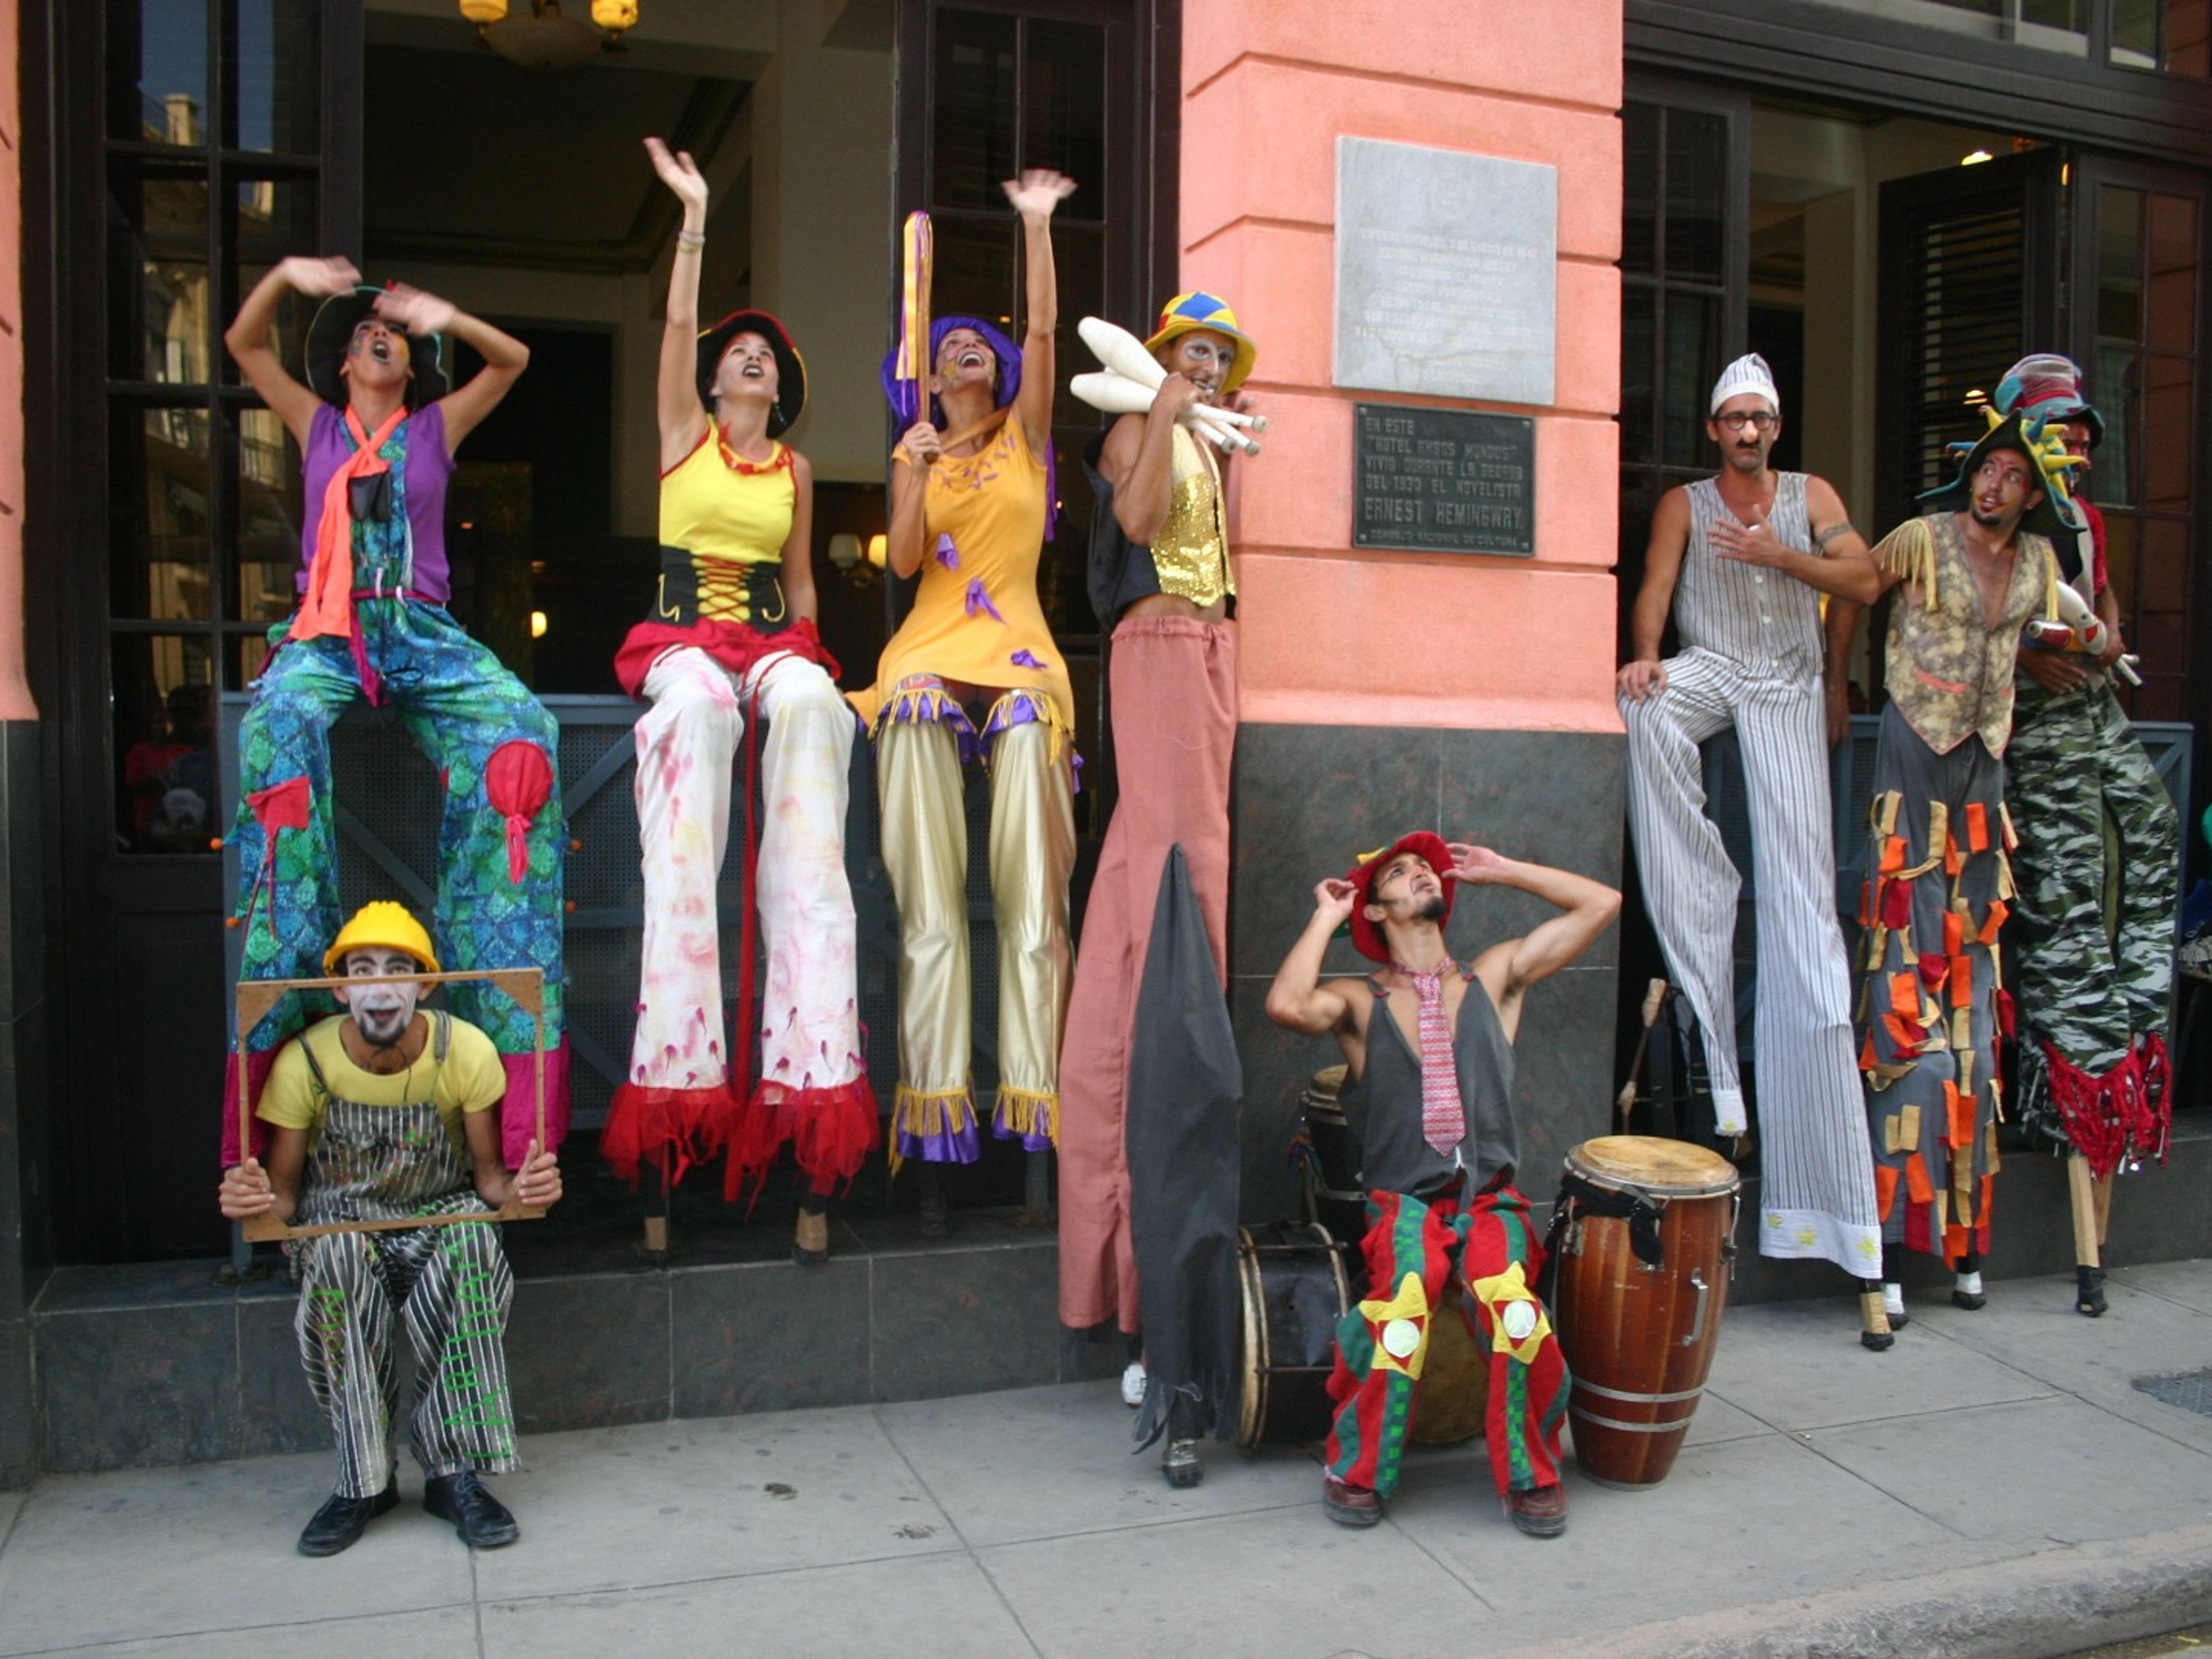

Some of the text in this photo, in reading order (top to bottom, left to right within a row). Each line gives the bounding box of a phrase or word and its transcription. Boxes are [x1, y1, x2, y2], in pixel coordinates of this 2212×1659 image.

[1365, 417, 1415, 435] EN ESTE
[1460, 461, 1476, 478] LA
[1365, 474, 1522, 499] DEL 1930 EL NOVELISTA
[1365, 497, 1424, 524] ERNEST
